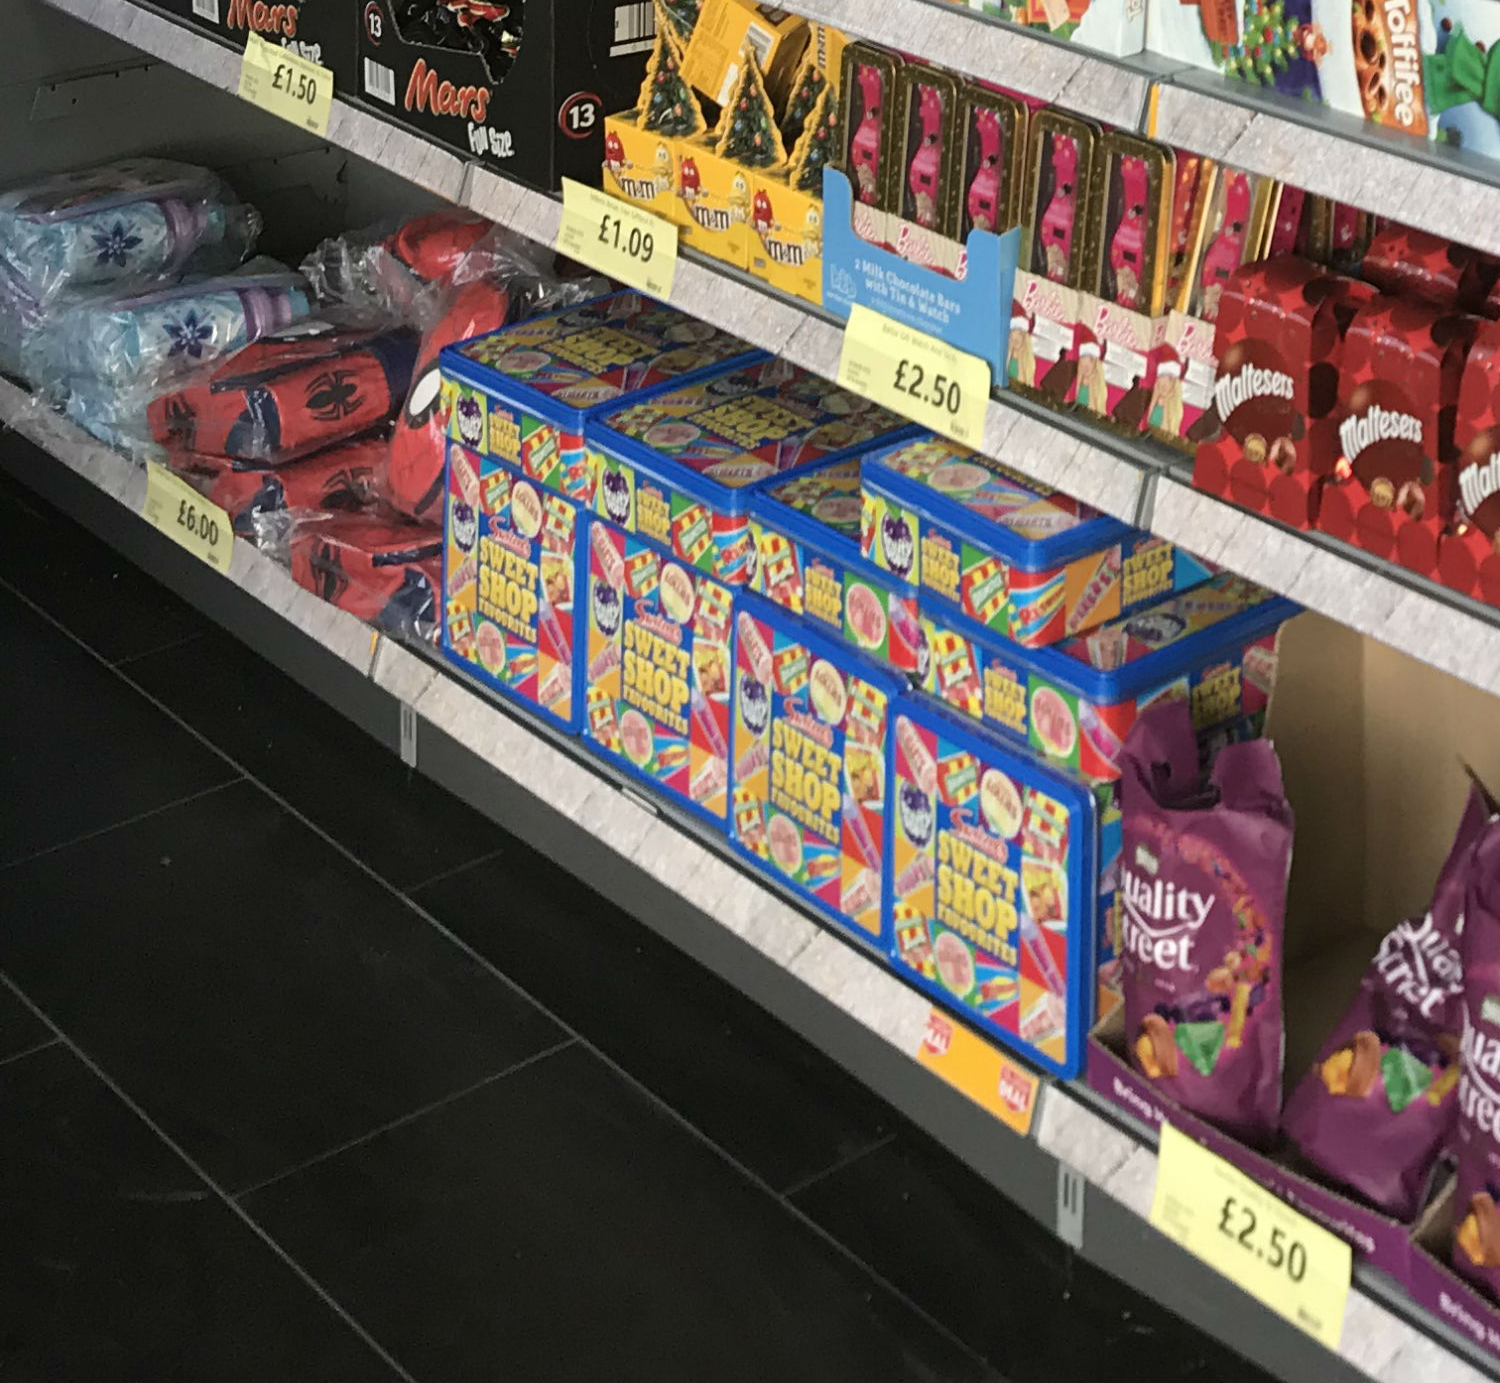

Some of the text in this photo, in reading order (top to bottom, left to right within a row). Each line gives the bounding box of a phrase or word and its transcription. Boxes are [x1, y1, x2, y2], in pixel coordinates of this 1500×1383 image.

[368, 9, 383, 38] 13
[272, 64, 318, 108] £1.50
[406, 58, 494, 124] Mars
[489, 129, 515, 159] Size
[568, 101, 596, 130] 13
[598, 213, 655, 264] £1.09
[893, 358, 961, 415] £2.50
[1214, 362, 1294, 424] Maltesers
[1339, 404, 1423, 462] Maltesers
[177, 499, 219, 547] £6.00
[478, 534, 540, 592] SWEET
[478, 568, 540, 622] SHOP
[623, 619, 691, 673] SWEET
[623, 649, 691, 710] SHOP
[771, 718, 844, 783] SWEET
[771, 754, 843, 817] SHOP
[937, 829, 1020, 896] SWEET
[937, 865, 1020, 936] SHOP
[1122, 868, 1215, 934] uality
[1218, 1196, 1308, 1284] £2.50
